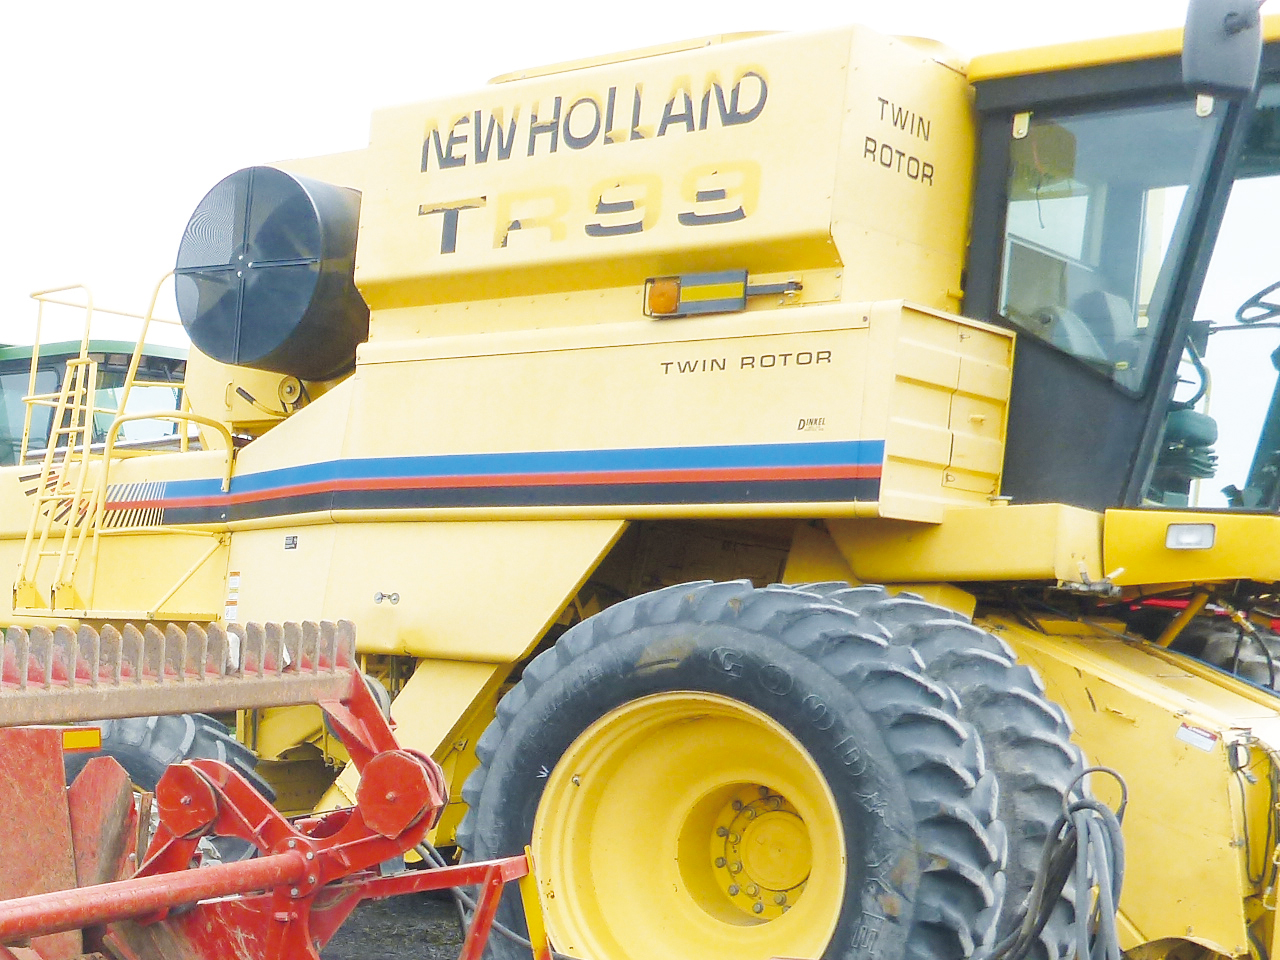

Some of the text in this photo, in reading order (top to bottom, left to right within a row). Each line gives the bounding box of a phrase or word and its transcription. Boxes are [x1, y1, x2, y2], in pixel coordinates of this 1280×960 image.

[526, 66, 768, 157] HOLLAND
[878, 96, 931, 142] TWIN
[863, 136, 935, 187] ROTOR
[660, 350, 832, 375] TWIN ROTOR
